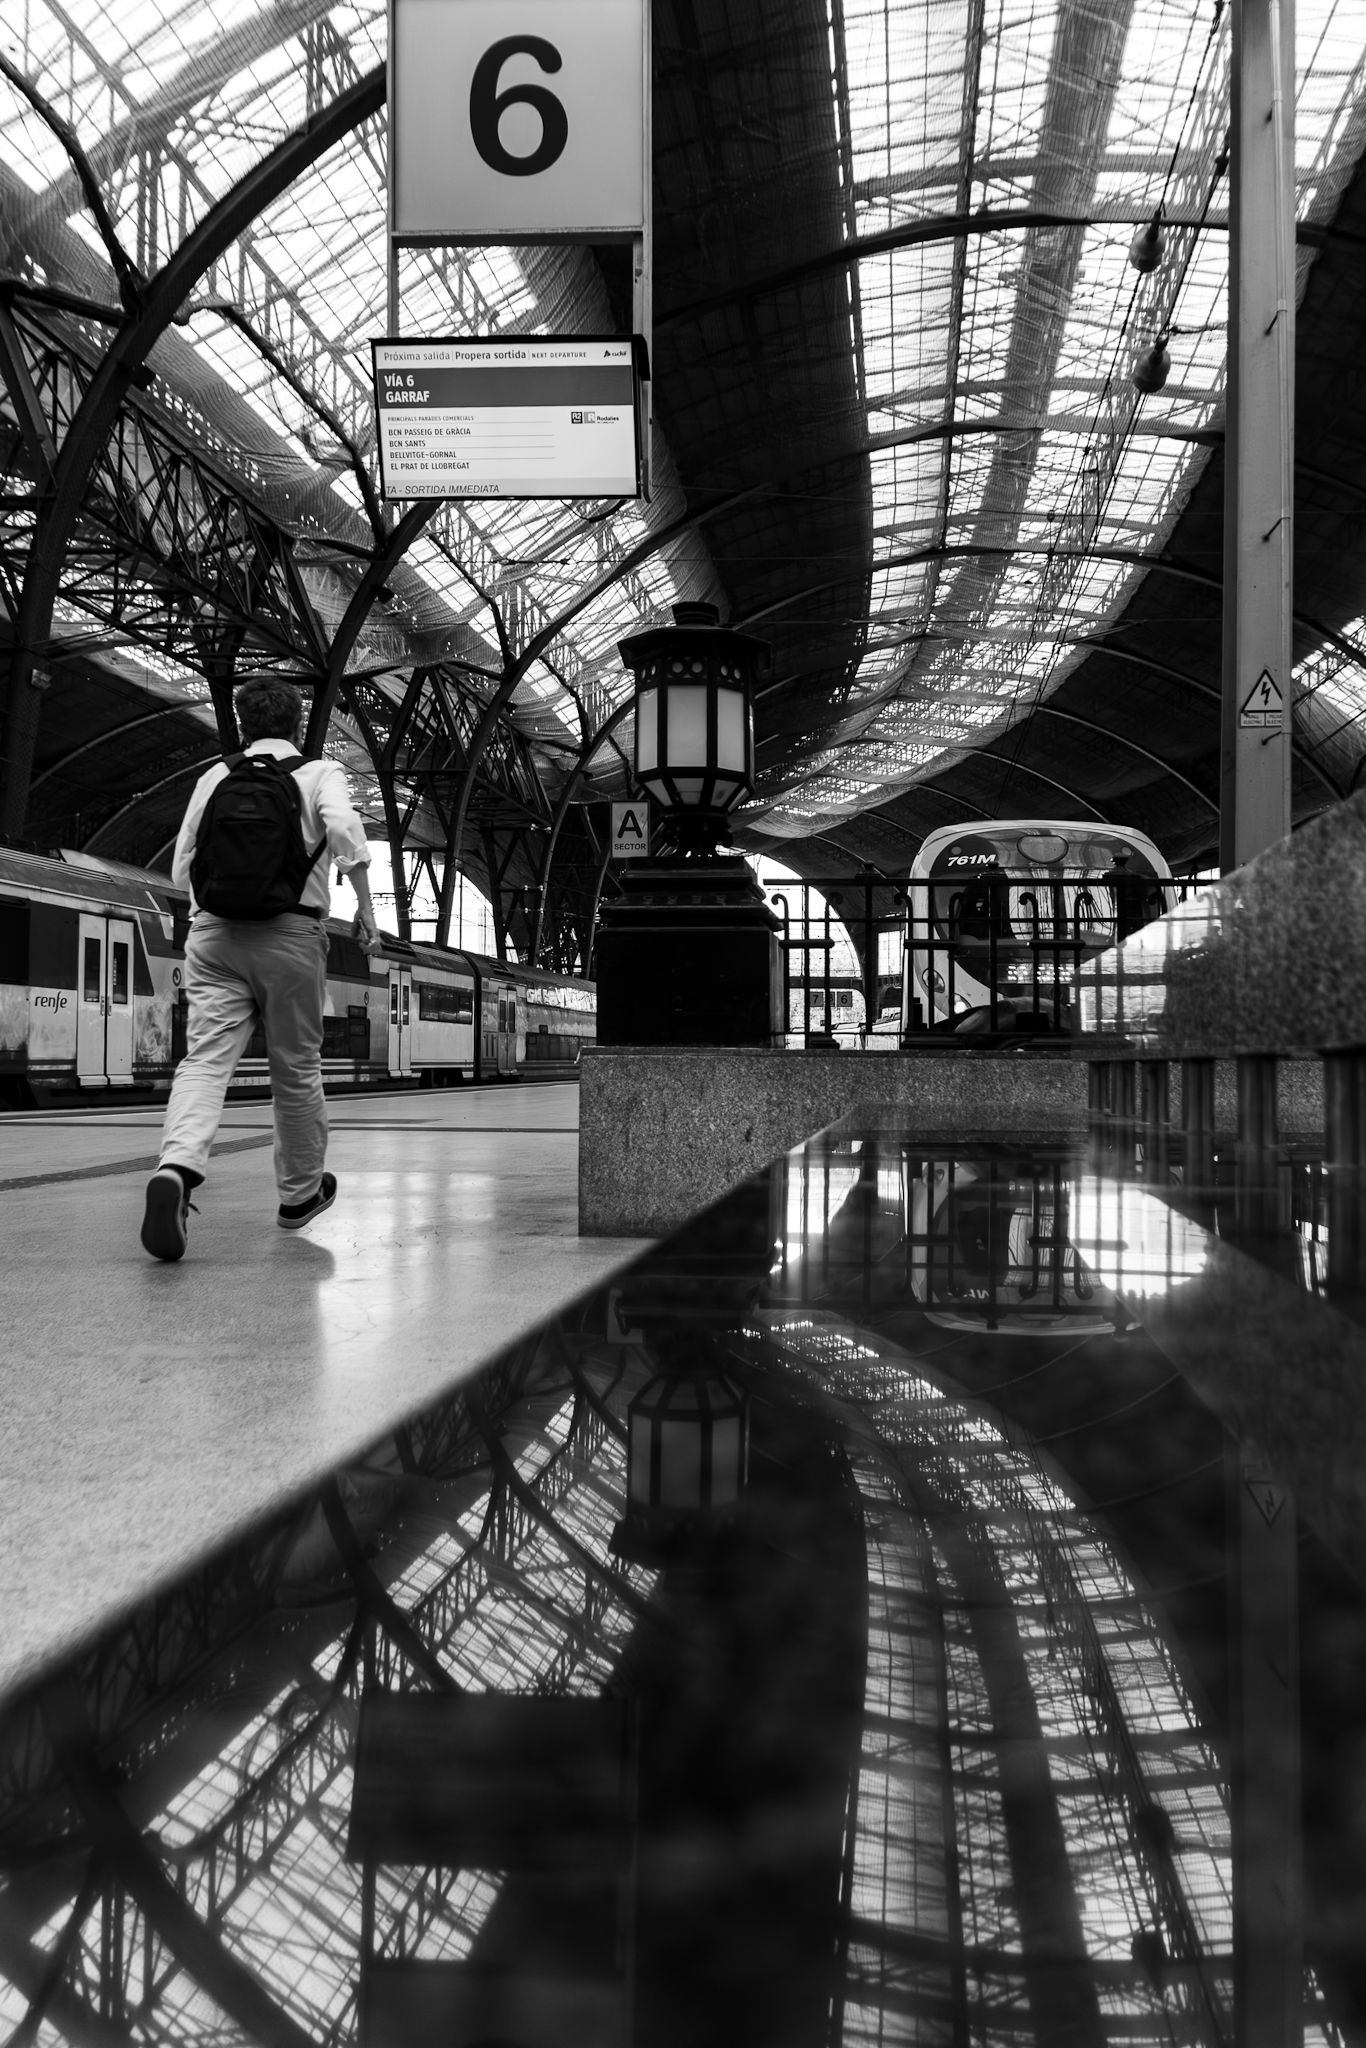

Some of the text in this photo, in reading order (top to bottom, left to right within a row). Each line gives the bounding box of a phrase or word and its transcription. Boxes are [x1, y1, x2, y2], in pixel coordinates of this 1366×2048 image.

[469, 34, 568, 177] 6
[384, 351, 450, 361] Próxima salida
[455, 350, 526, 361] Propera sortida
[384, 373, 414, 387] VÍA 6
[386, 391, 430, 403] GARRAF
[446, 427, 471, 435] GRÀCIA
[387, 486, 396, 494] TA
[405, 485, 446, 494] SORTIDA
[449, 485, 499, 493] IMMEDIATA
[617, 810, 643, 838] A
[948, 855, 996, 866] 761M
[34, 991, 67, 1013] renfe
[813, 995, 819, 1004] 7
[841, 995, 847, 1004] 6
